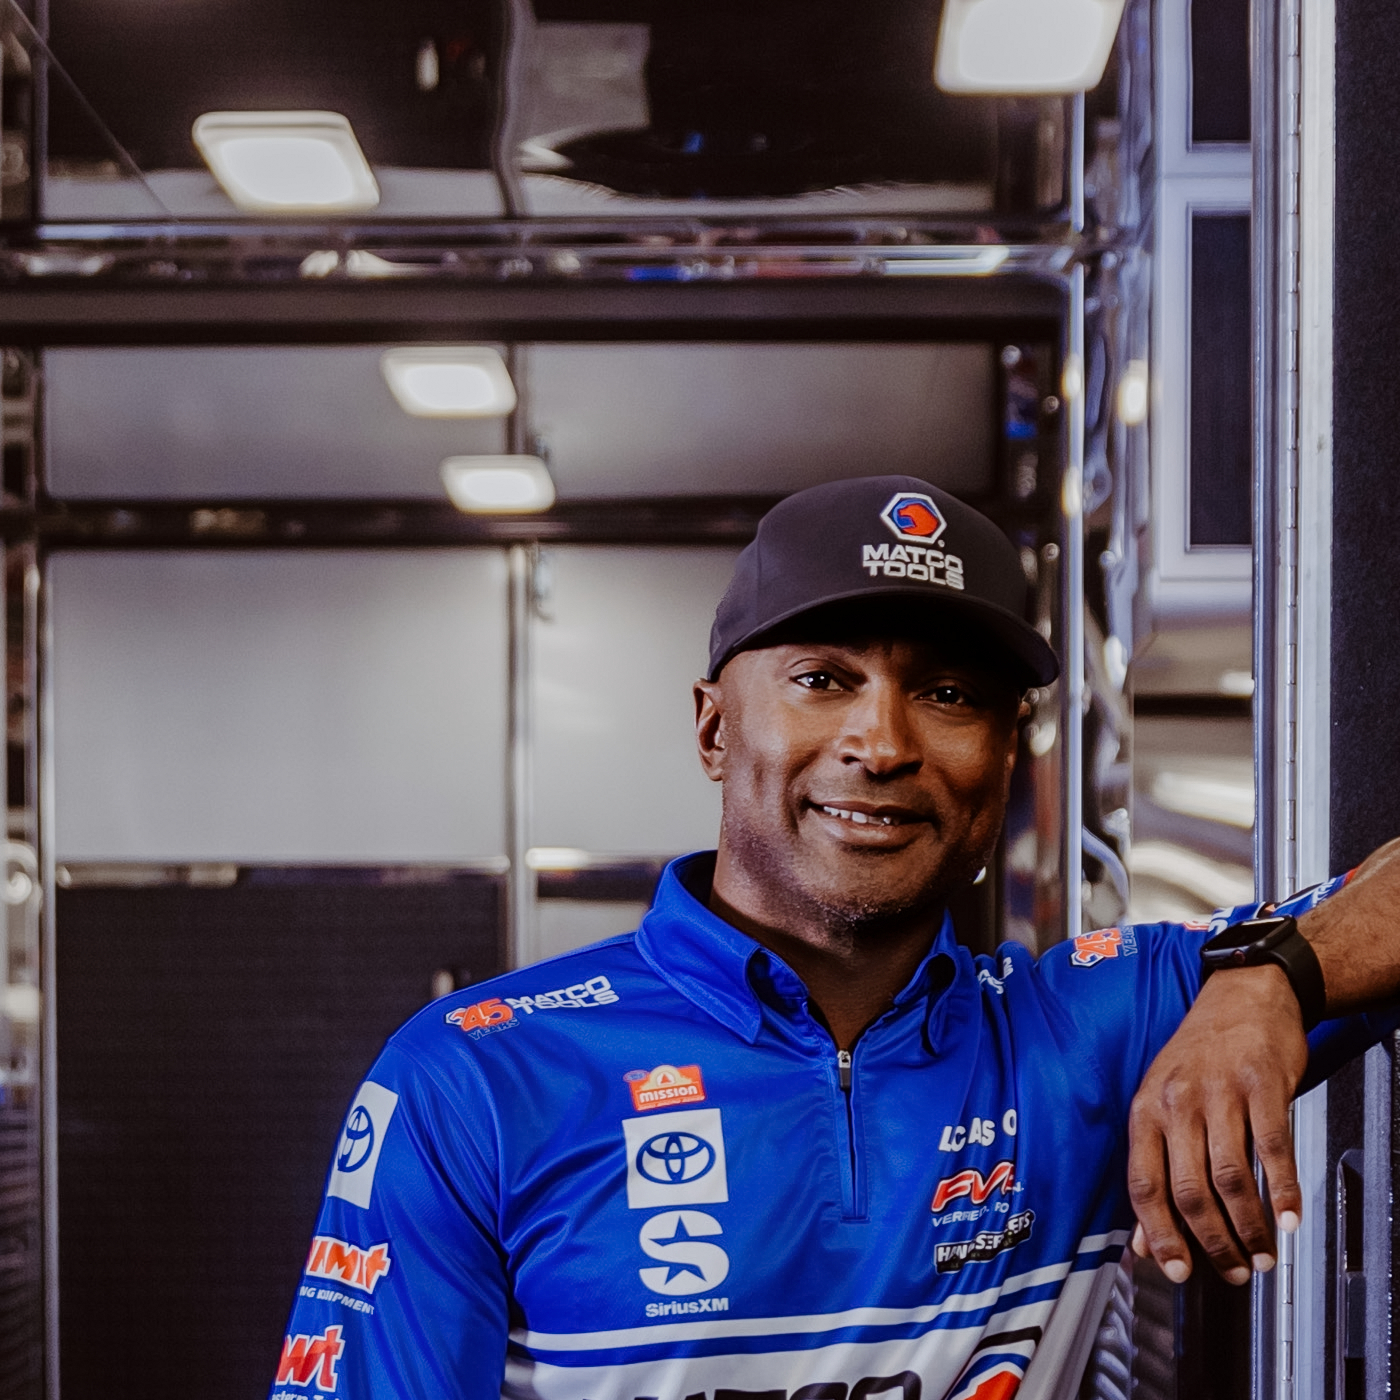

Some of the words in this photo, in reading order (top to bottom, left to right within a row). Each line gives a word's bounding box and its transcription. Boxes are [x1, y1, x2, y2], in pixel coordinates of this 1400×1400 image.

[862, 543, 964, 574] MATCO
[862, 560, 965, 590] TOOLS
[504, 975, 611, 1006] MATCO
[512, 989, 620, 1015] TOOLS
[461, 998, 514, 1032] 45
[468, 1017, 521, 1041] YEARS
[645, 1298, 730, 1317] SiriusXM
